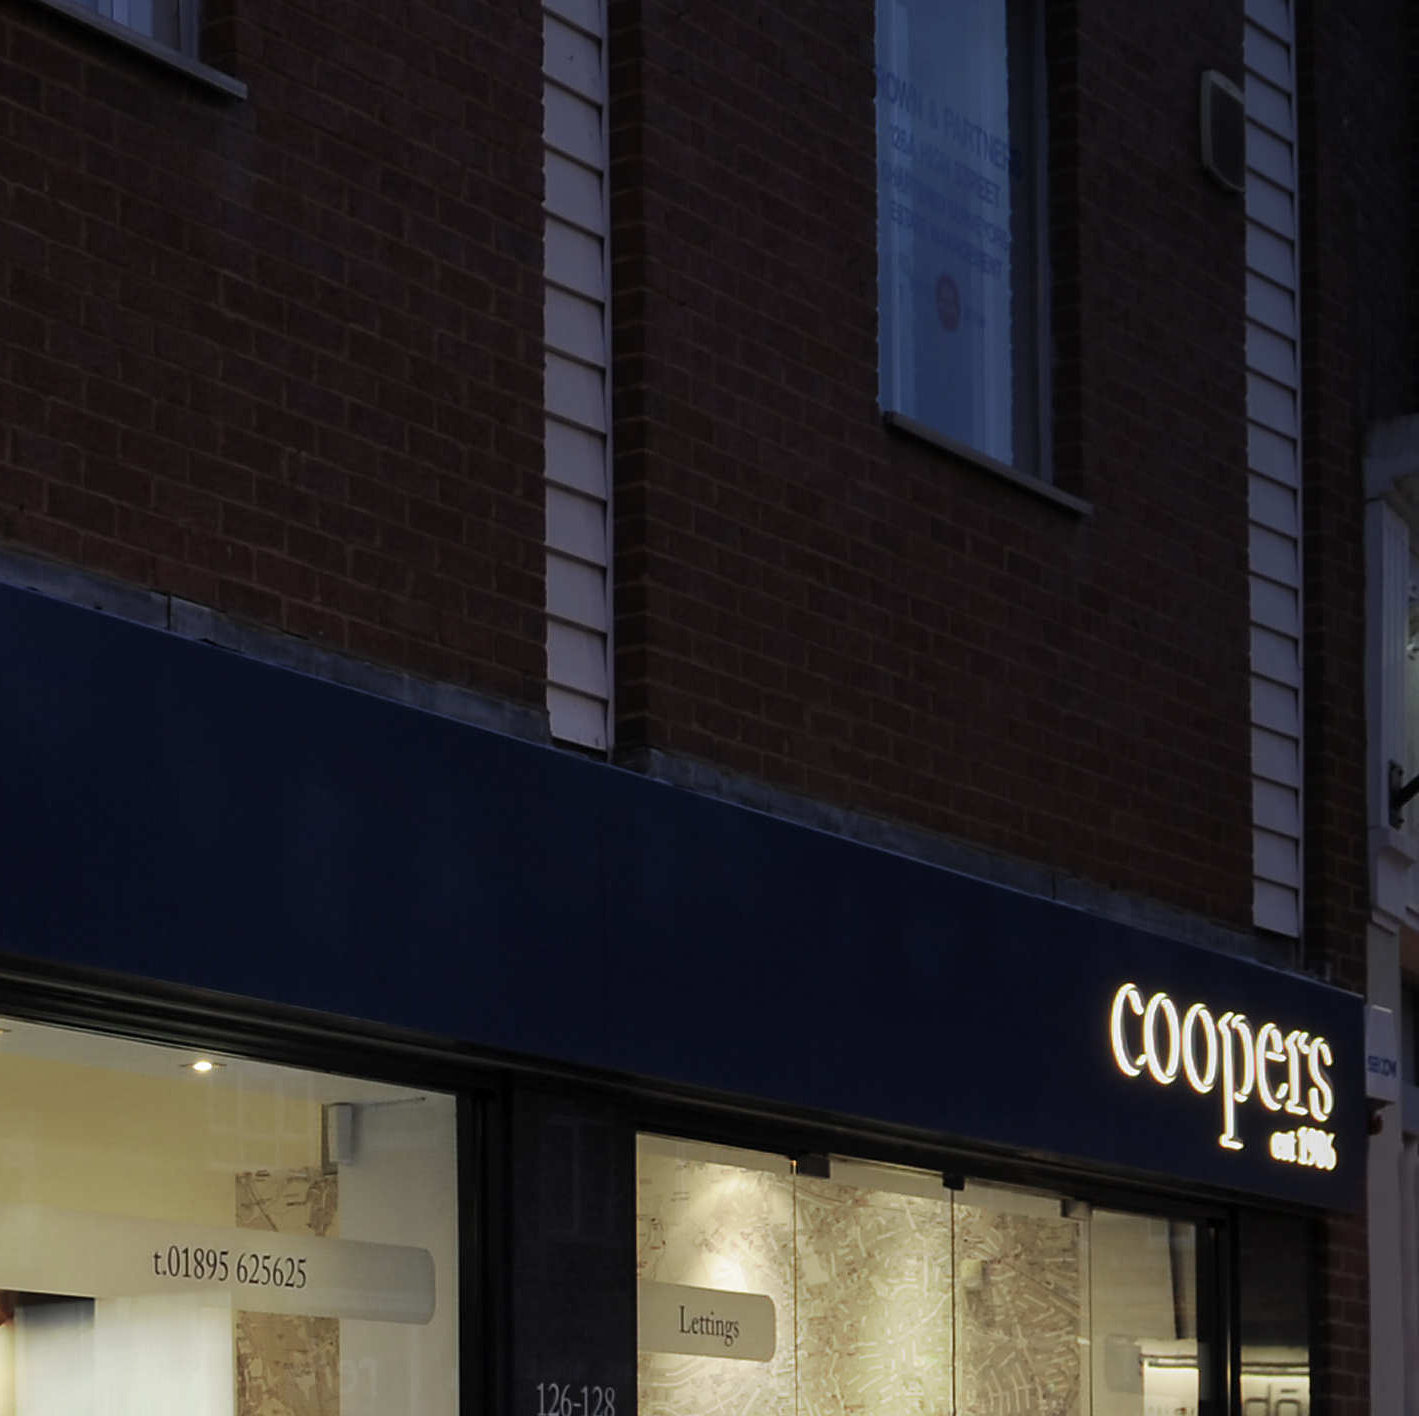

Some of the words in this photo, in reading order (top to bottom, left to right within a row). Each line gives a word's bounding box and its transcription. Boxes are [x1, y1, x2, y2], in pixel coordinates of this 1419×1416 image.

[875, 64, 923, 121] ROWN
[954, 160, 1001, 208] STREET
[1111, 982, 1334, 1150] coopers
[152, 1244, 229, 1284] t.01895
[235, 1249, 308, 1291] 625625
[679, 1305, 740, 1347] Lettings
